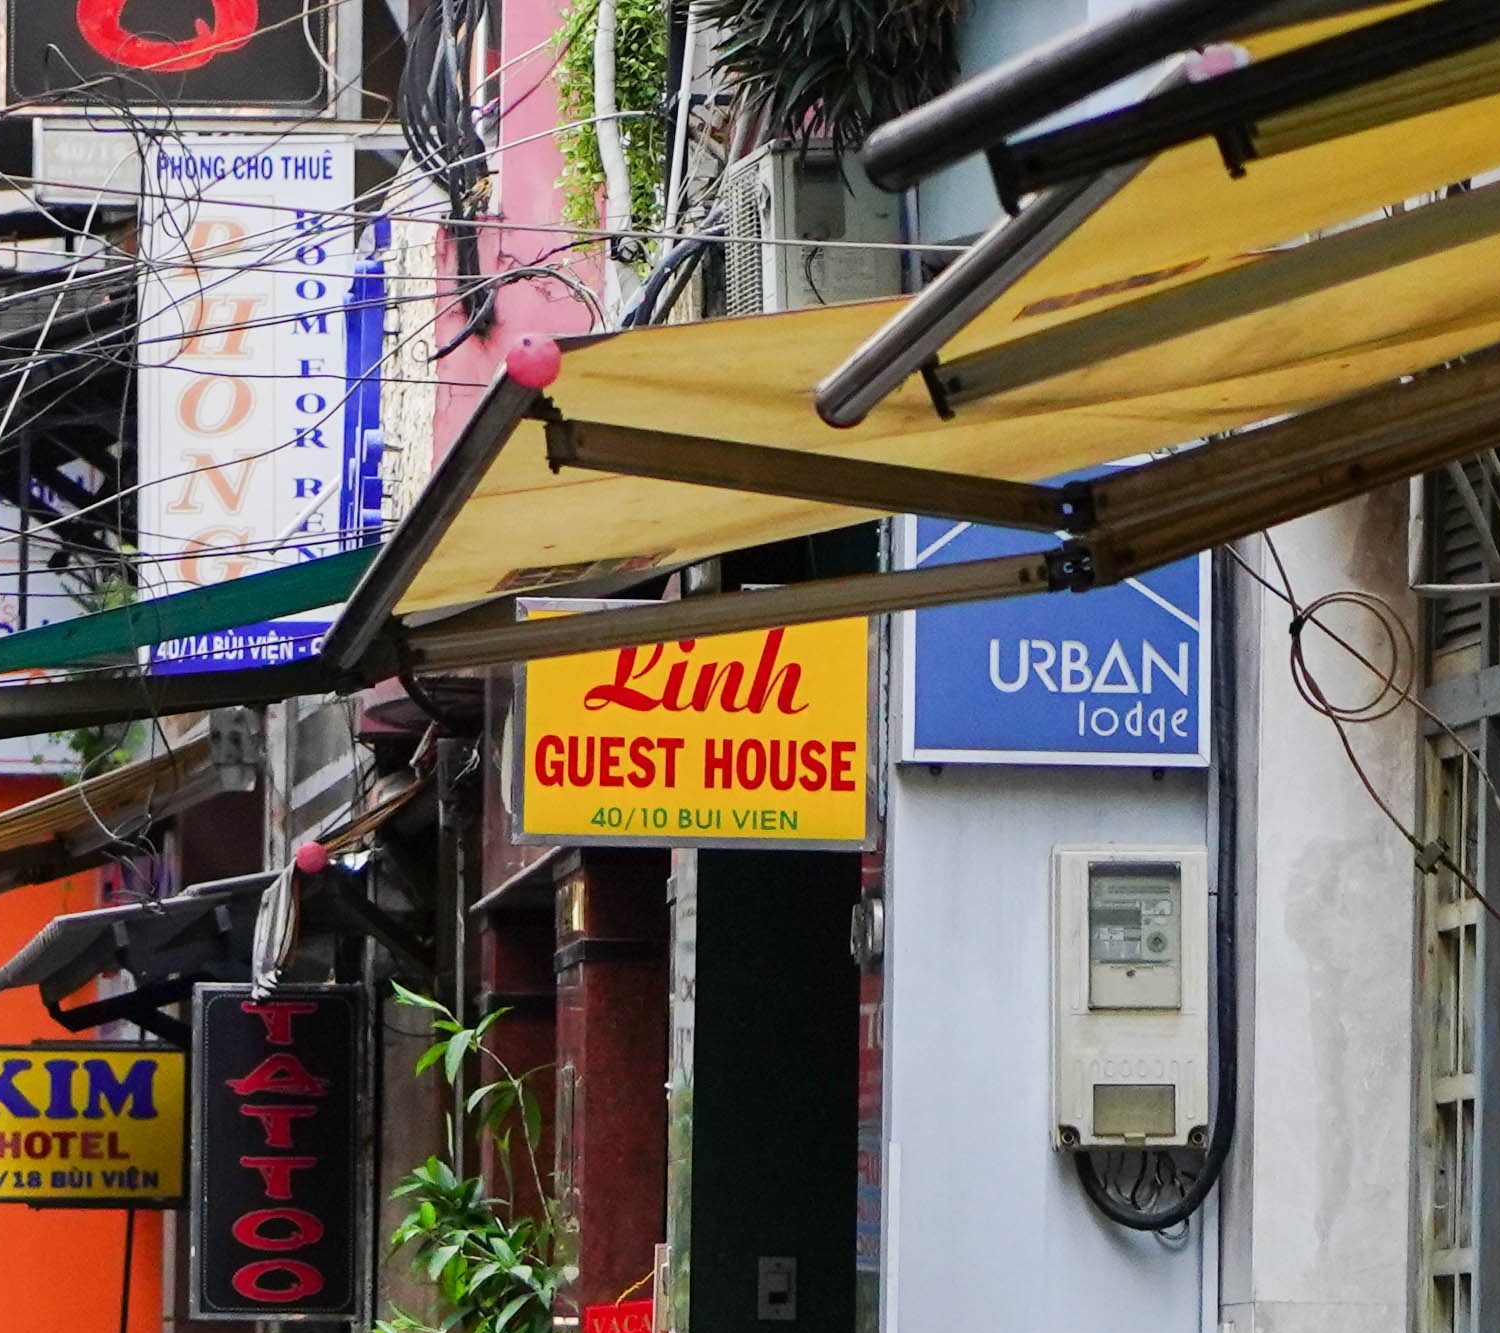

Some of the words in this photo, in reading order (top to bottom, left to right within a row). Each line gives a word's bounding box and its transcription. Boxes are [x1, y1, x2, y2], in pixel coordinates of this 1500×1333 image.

[232, 156, 274, 181] CHO
[280, 149, 334, 181] THUÊ
[212, 630, 245, 662] BÙI
[248, 629, 295, 667] VIỆN
[989, 638, 1190, 697] URBAN
[583, 626, 809, 717] Linh
[1078, 699, 1189, 744] lodge
[534, 733, 685, 791] GUEST
[703, 737, 858, 793] HOUSE
[590, 806, 668, 832] 40/10
[677, 808, 723, 832] BUI
[732, 808, 800, 832] VIEN
[225, 1000, 331, 1303] TATTOO
[50, 1165, 94, 1190] BÙI
